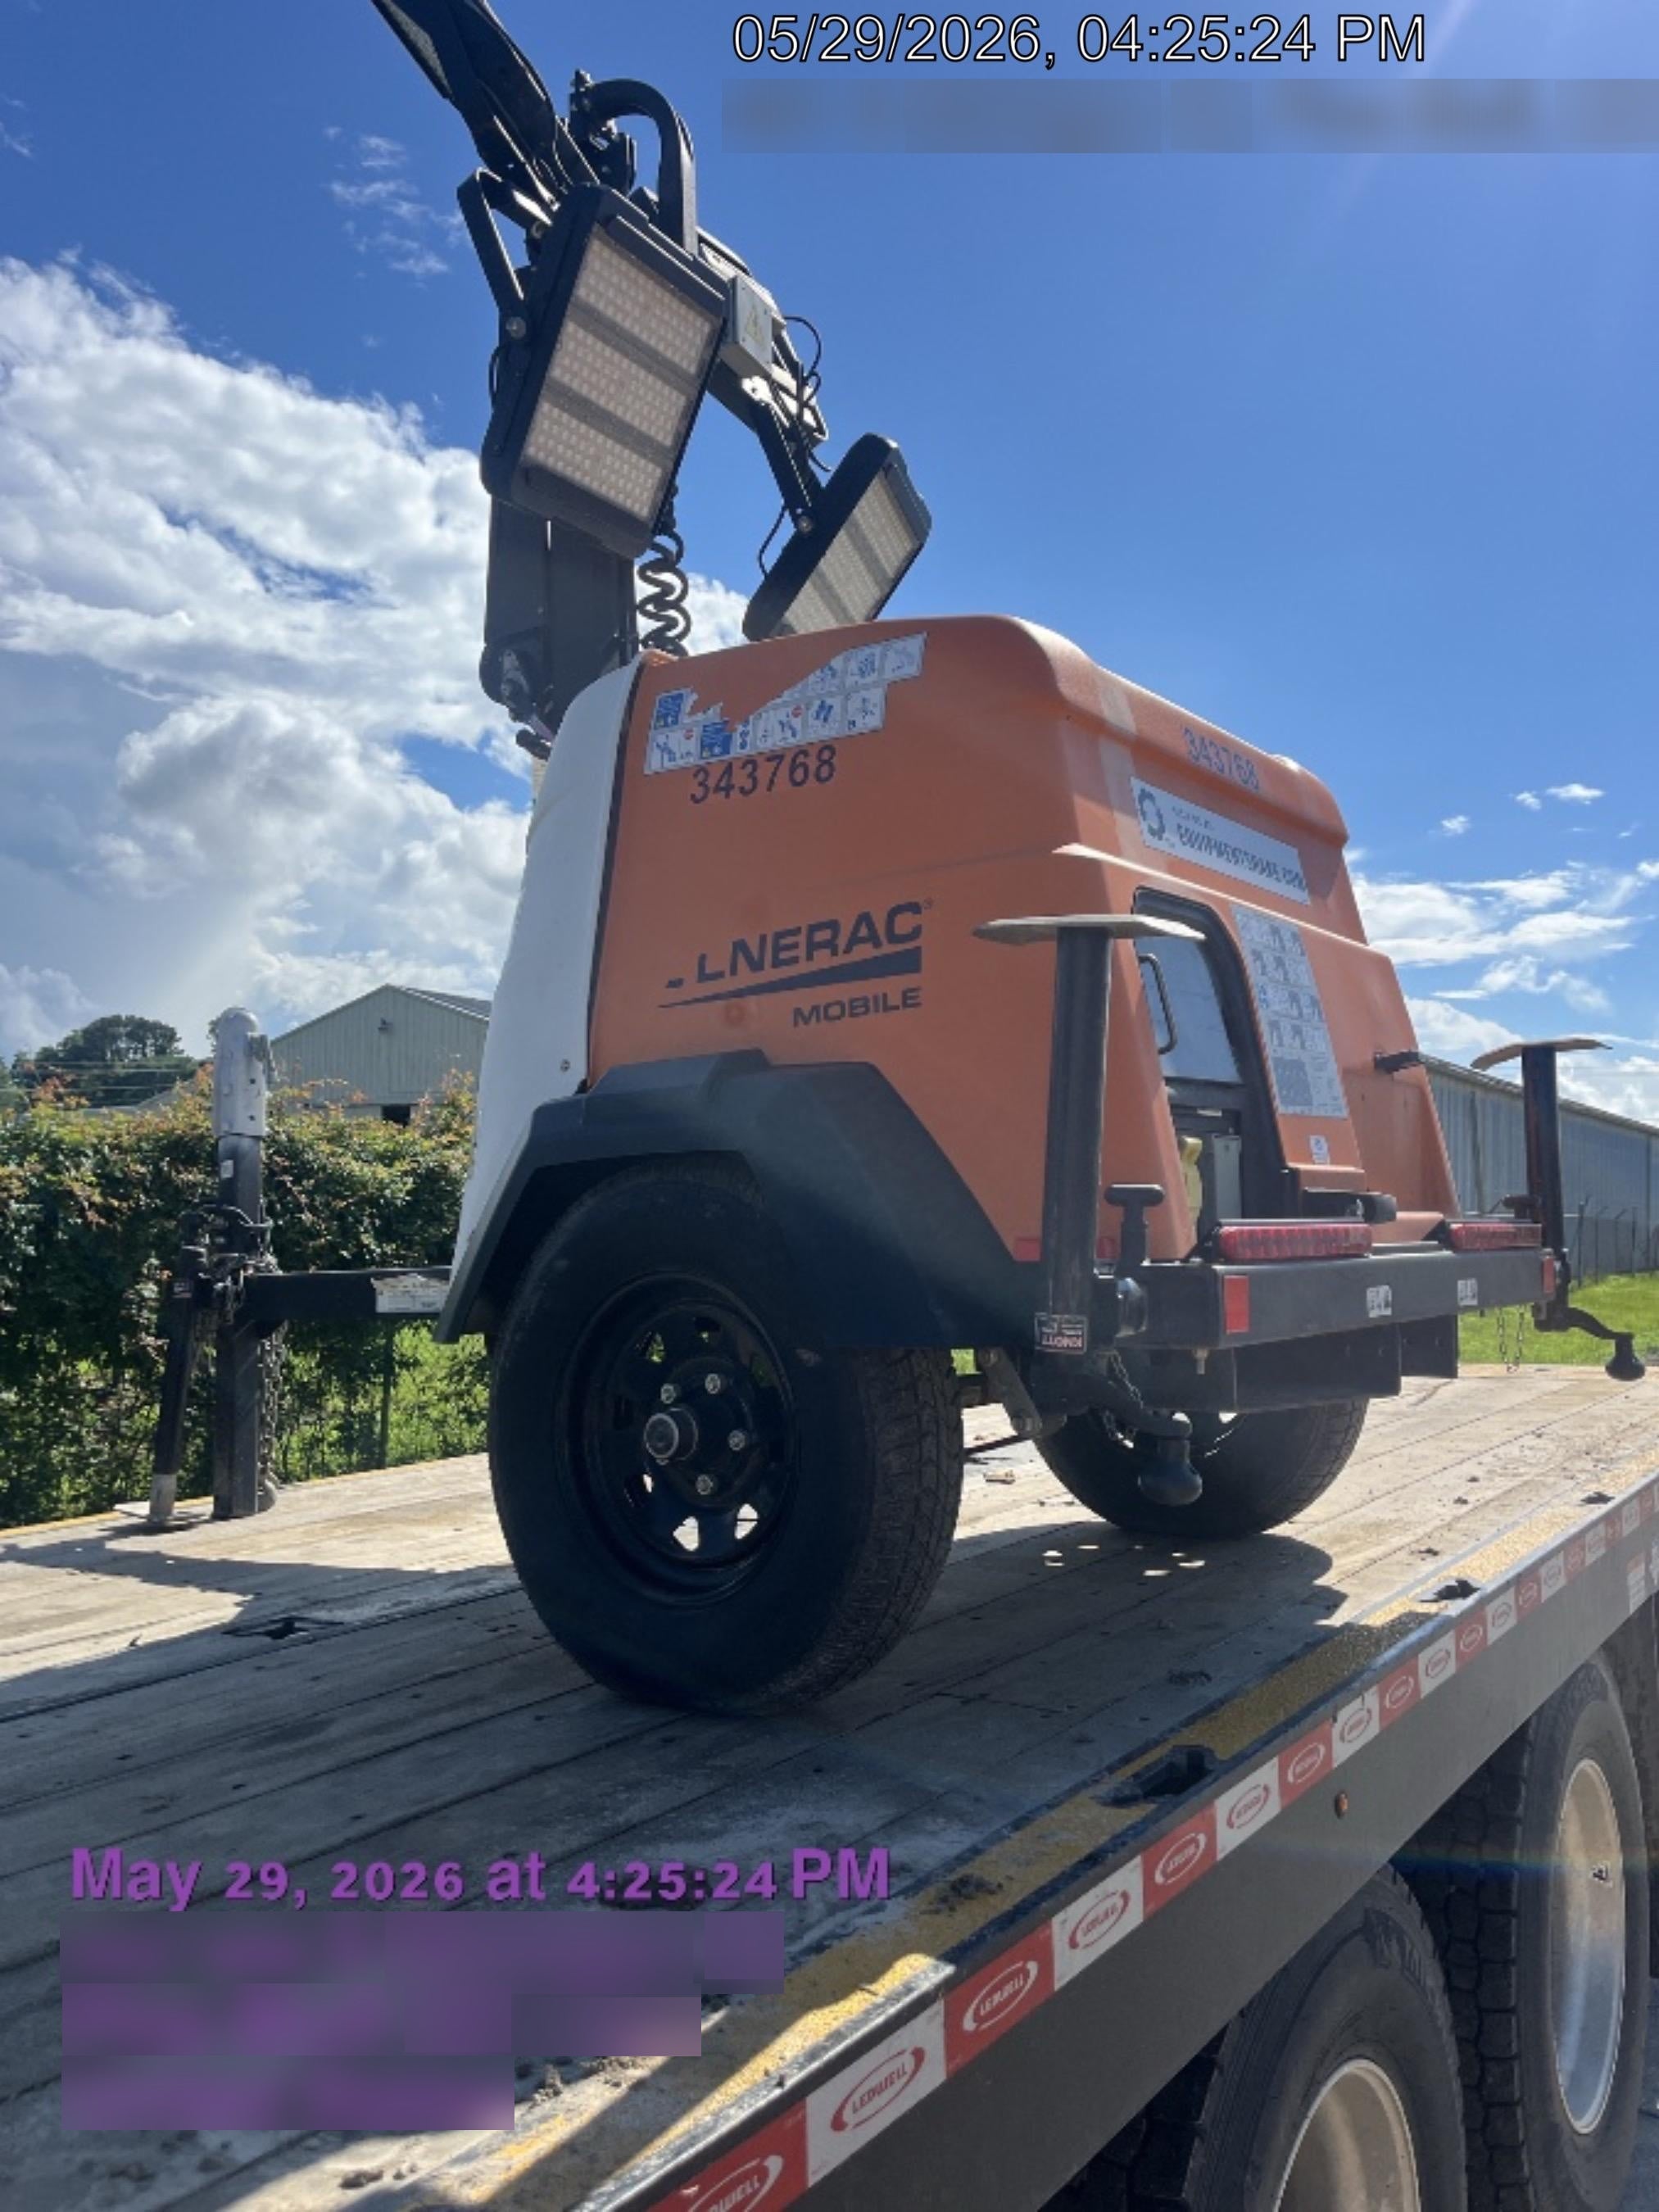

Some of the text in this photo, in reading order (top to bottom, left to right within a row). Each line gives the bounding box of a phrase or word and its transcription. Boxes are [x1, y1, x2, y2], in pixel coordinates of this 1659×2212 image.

[690, 744, 836, 805] 343768
[665, 901, 922, 989] NERAC
[793, 986, 922, 1027] MOBILE
[852, 2062, 907, 2115] LEDWELL
